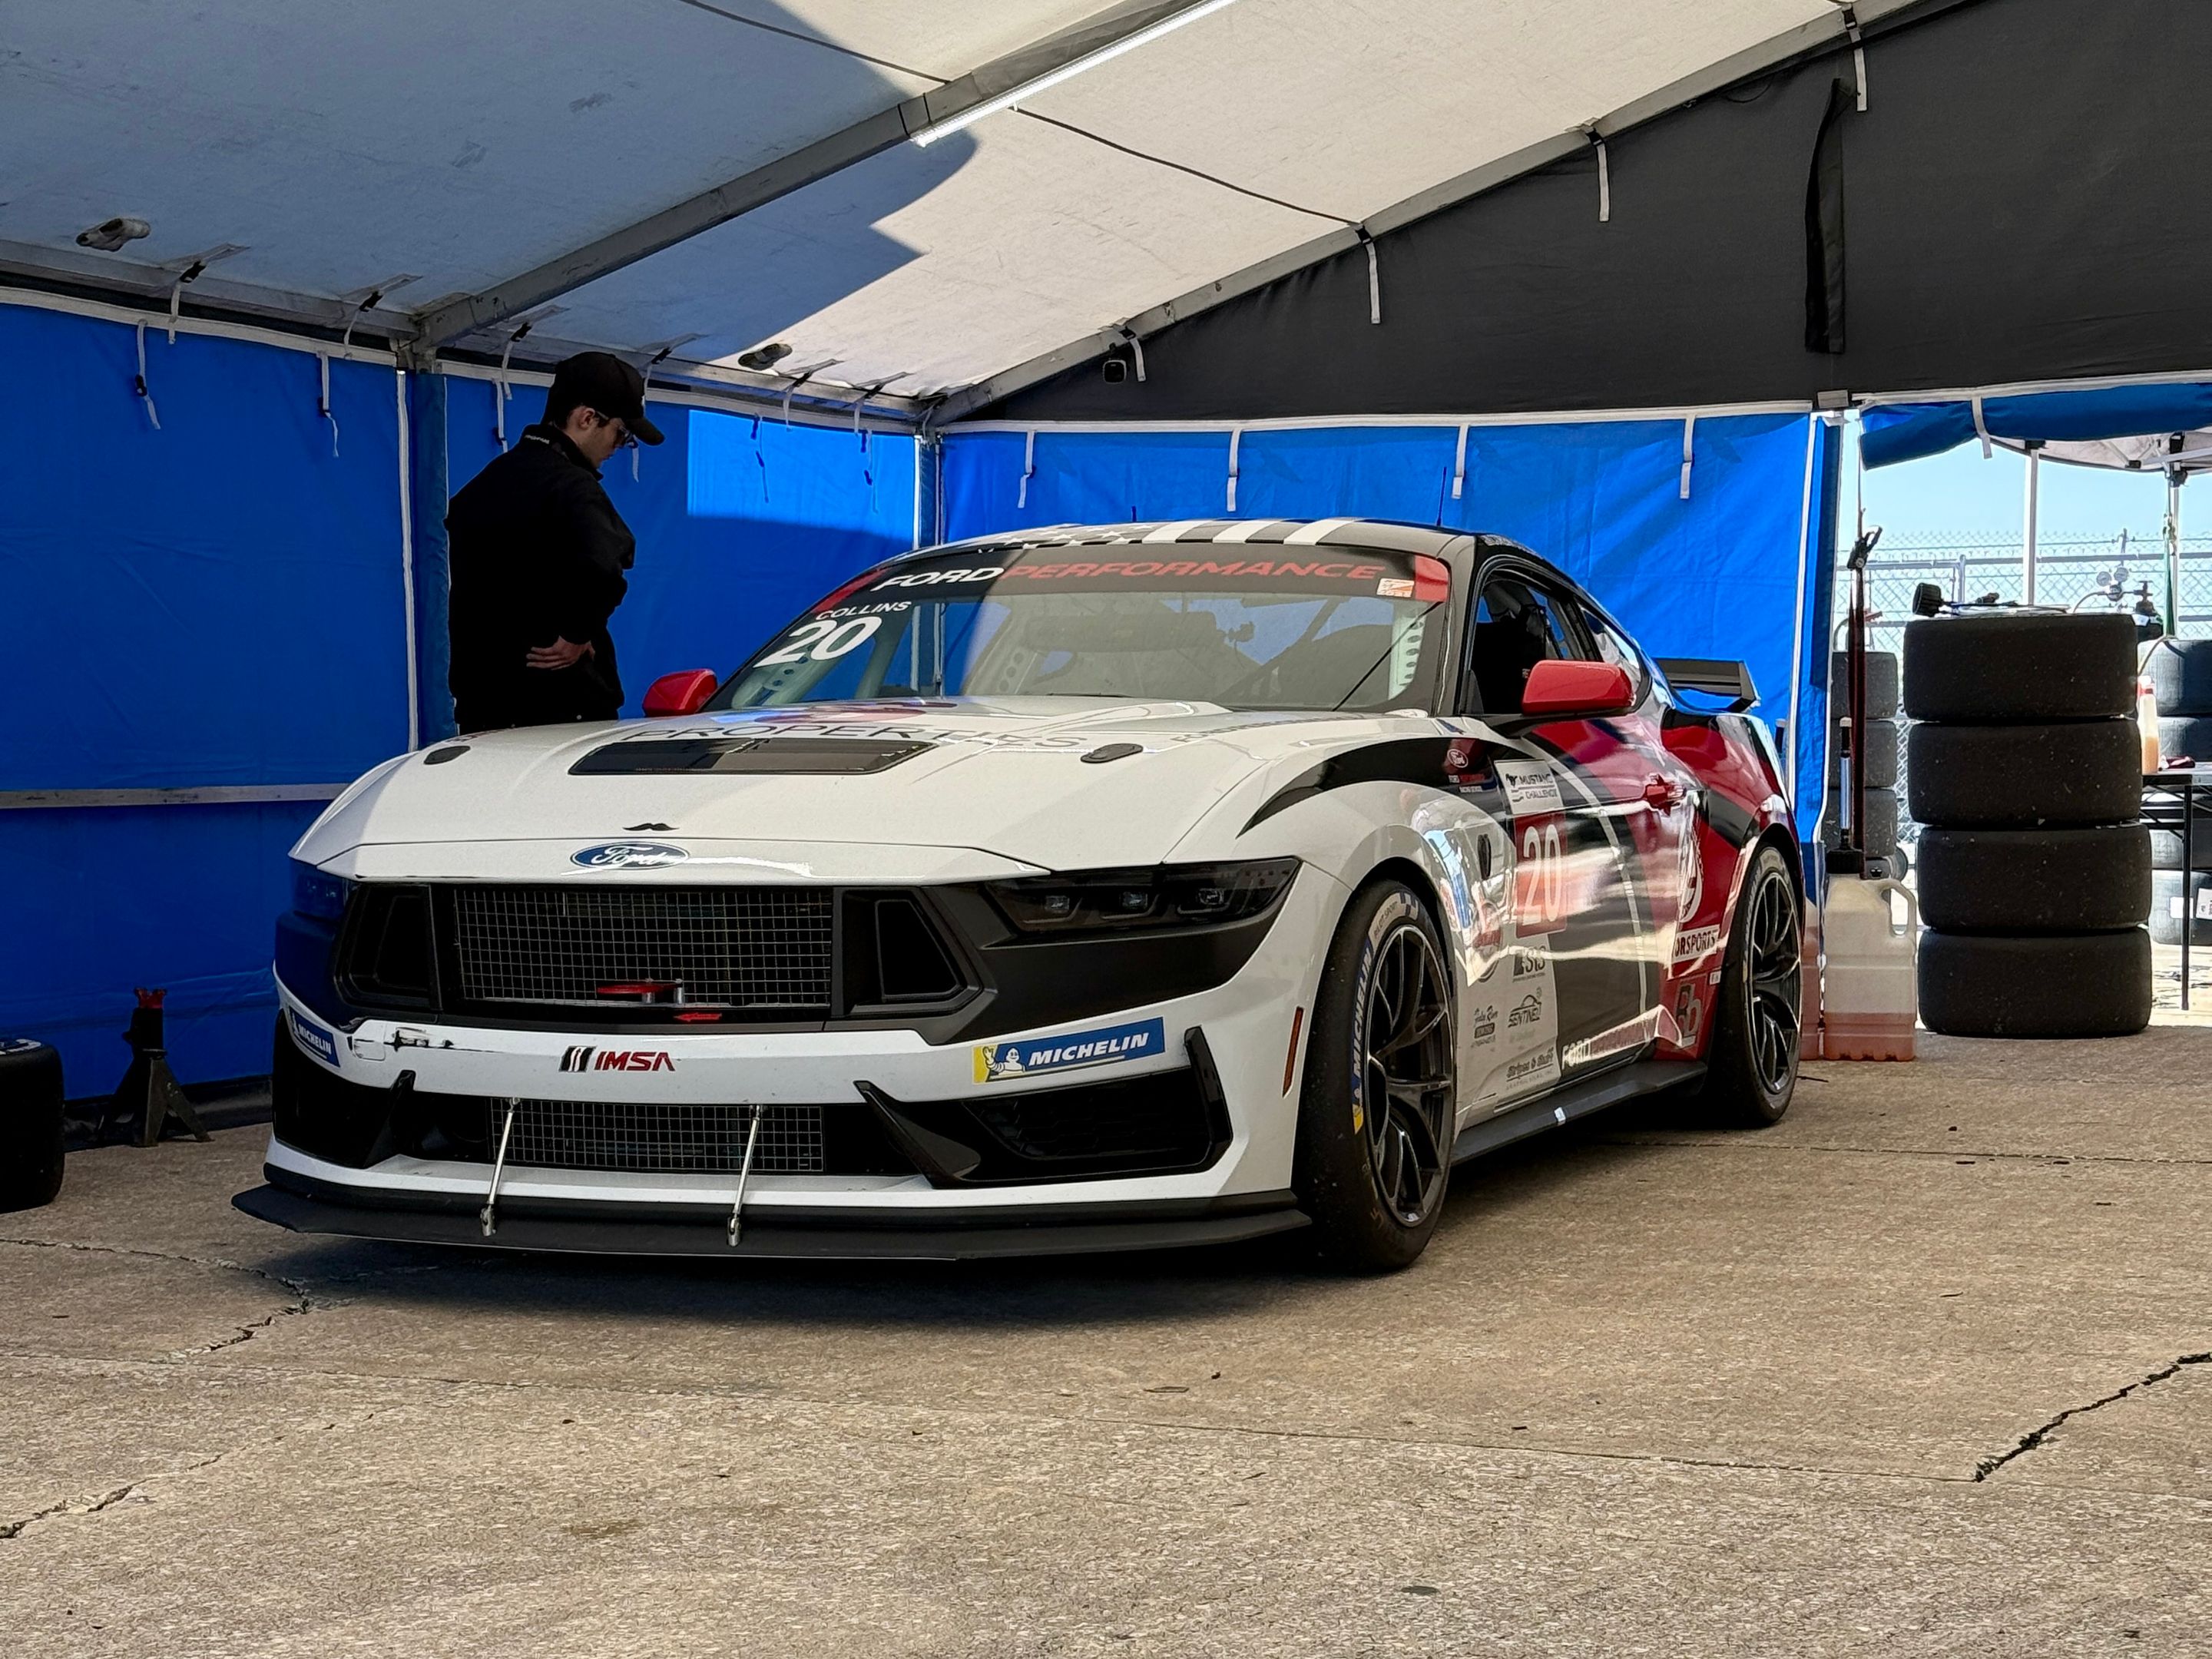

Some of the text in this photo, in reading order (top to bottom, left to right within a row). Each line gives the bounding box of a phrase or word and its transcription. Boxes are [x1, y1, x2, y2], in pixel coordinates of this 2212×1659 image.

[816, 601, 912, 621] COLLINS
[753, 616, 882, 668] 20
[591, 845, 668, 866] Ford
[1522, 823, 1562, 926] 20
[1353, 946, 1373, 1079] MICHELIN
[297, 1022, 333, 1055] MICHELIN
[1028, 1031, 1150, 1067] MICHELIN
[594, 1051, 676, 1072] IMSA
